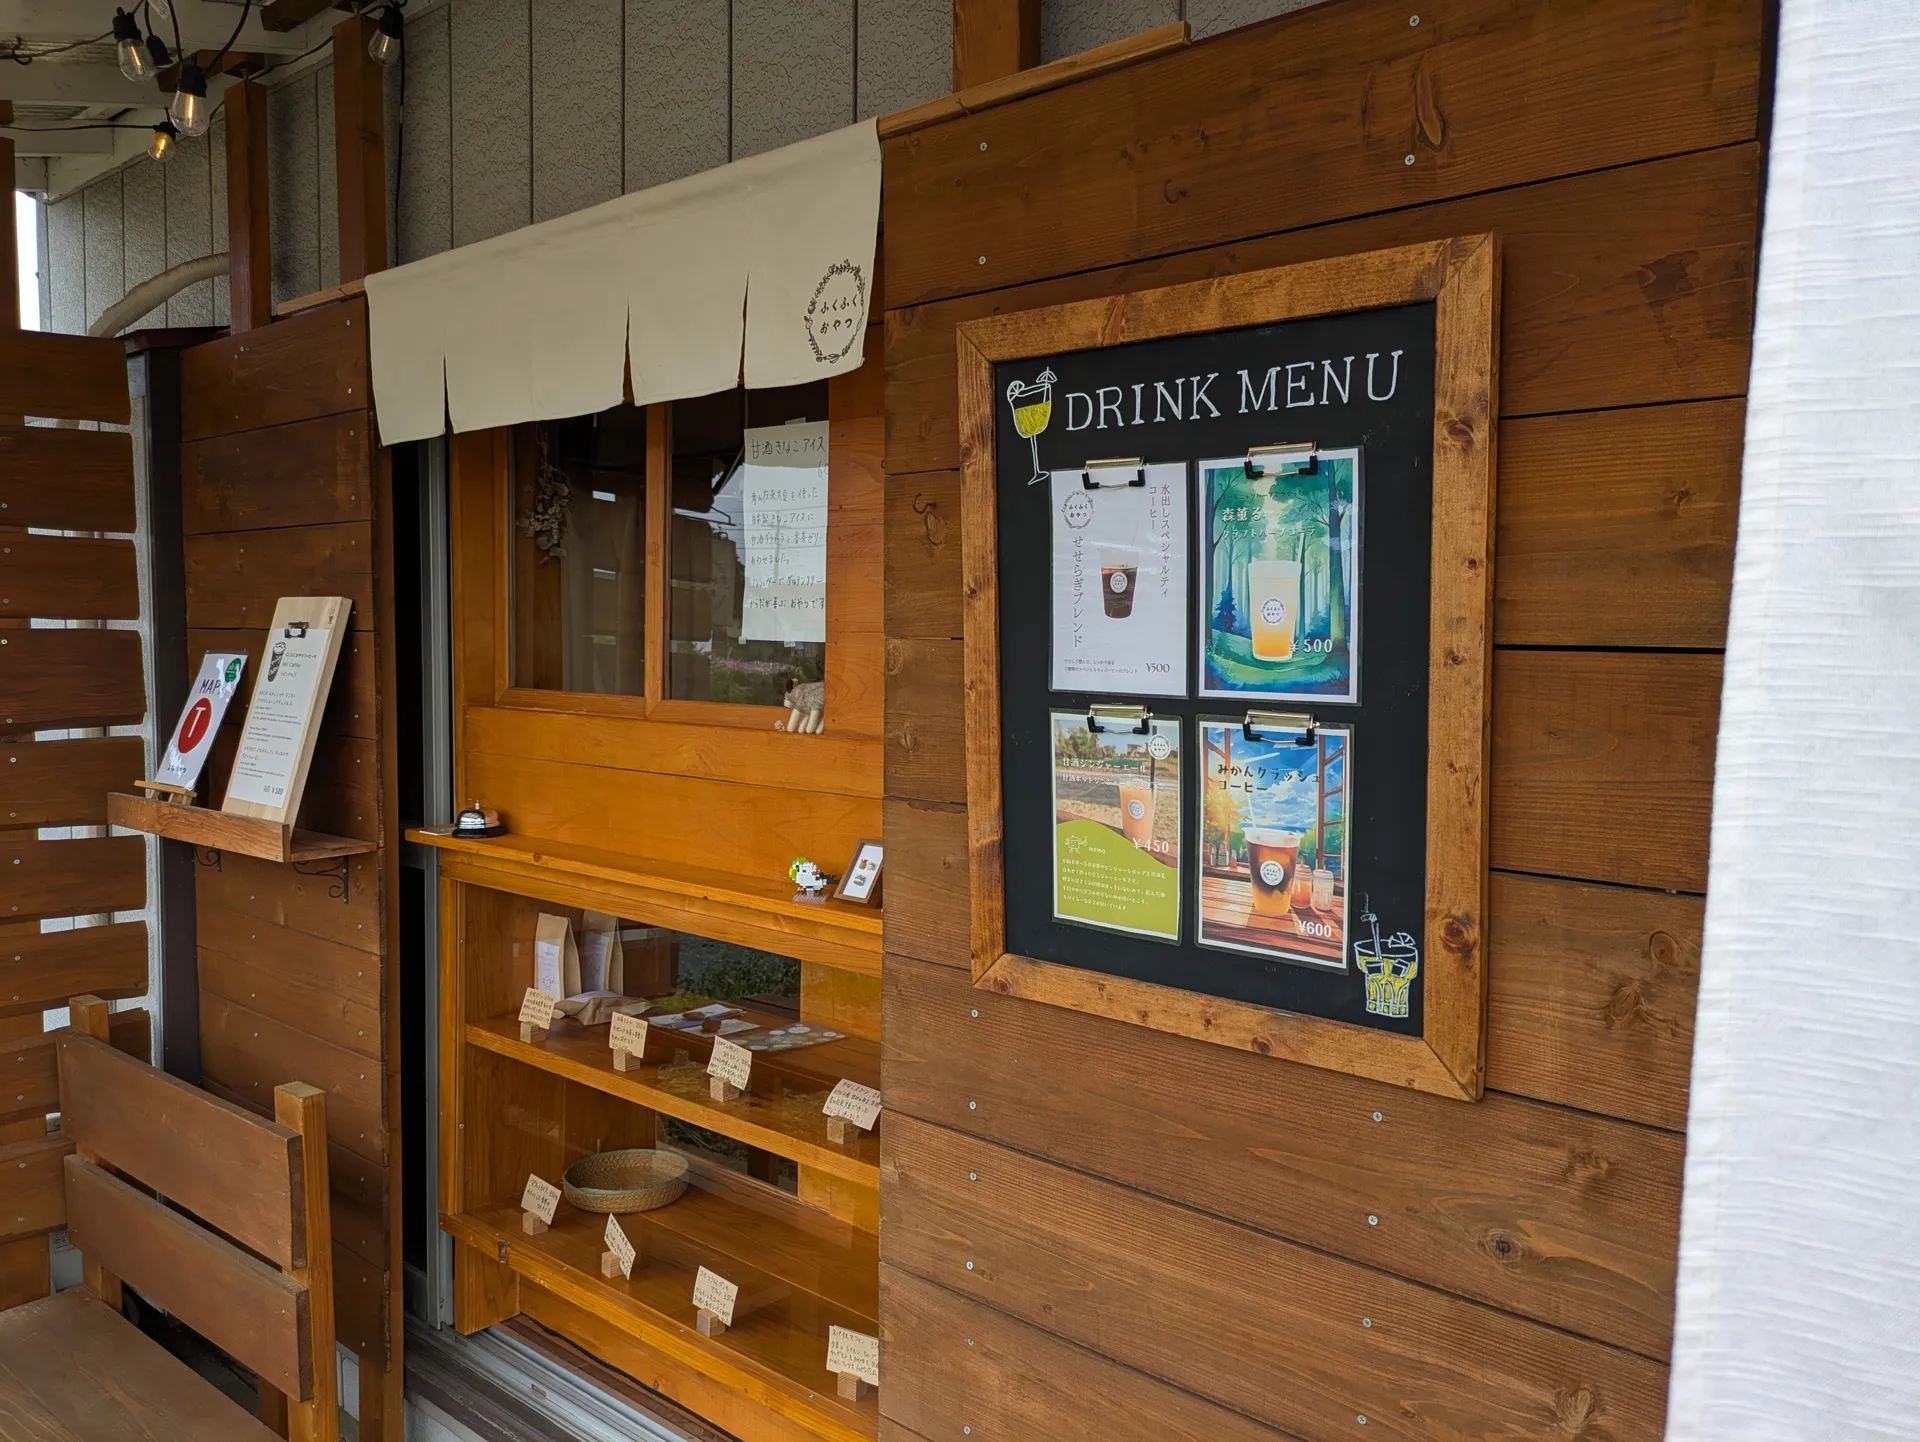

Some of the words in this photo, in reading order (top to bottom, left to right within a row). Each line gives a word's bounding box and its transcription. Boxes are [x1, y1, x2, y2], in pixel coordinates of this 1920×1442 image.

[820, 294, 858, 315] ふくふく
[820, 318, 853, 335] おやつ
[1065, 372, 1222, 432] DRINK
[1236, 350, 1404, 414] MENU
[1149, 486, 1157, 530] コーヒー
[1221, 506, 1262, 523] 森薫る
[1160, 483, 1171, 598] 水出しスペシャルティ
[1072, 536, 1084, 648] せせらぎブレンド
[1145, 662, 1170, 674] ¥500
[187, 706, 207, 738] T
[1063, 758, 1148, 773] 甘酒ジンジャーエール
[1217, 764, 1321, 783] みかんクラッシュ
[1218, 780, 1268, 793] コーヒー
[1132, 837, 1169, 853] ¥450
[1298, 920, 1332, 938] ¥600
